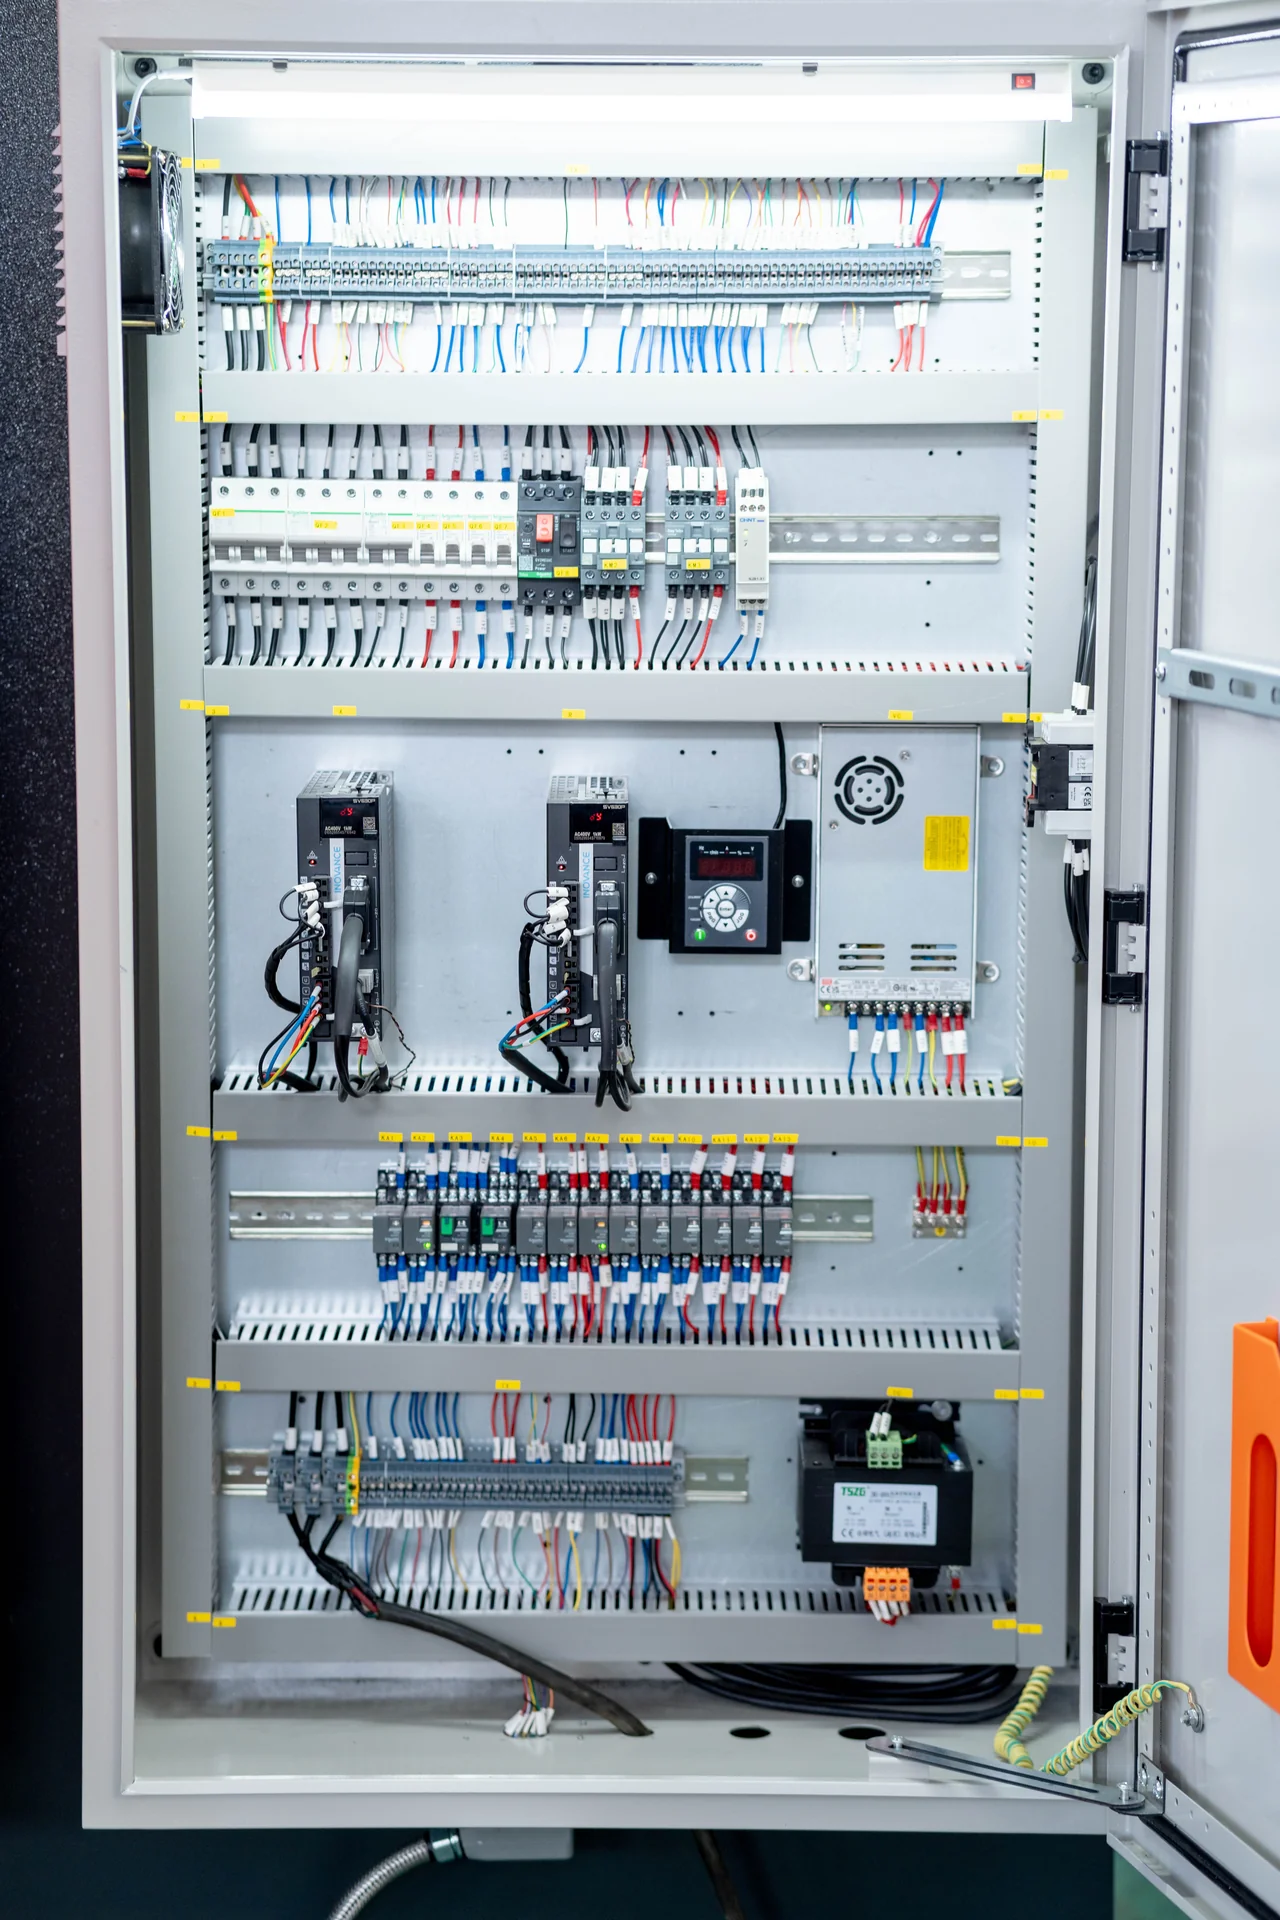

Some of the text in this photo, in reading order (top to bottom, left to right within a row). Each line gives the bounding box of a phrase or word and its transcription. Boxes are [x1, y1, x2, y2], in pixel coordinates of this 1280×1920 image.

[333, 846, 342, 894] INOVANCE
[582, 851, 591, 899] INOVANCE
[841, 1486, 866, 1497] TSZG
[841, 1528, 854, 1538] CE
